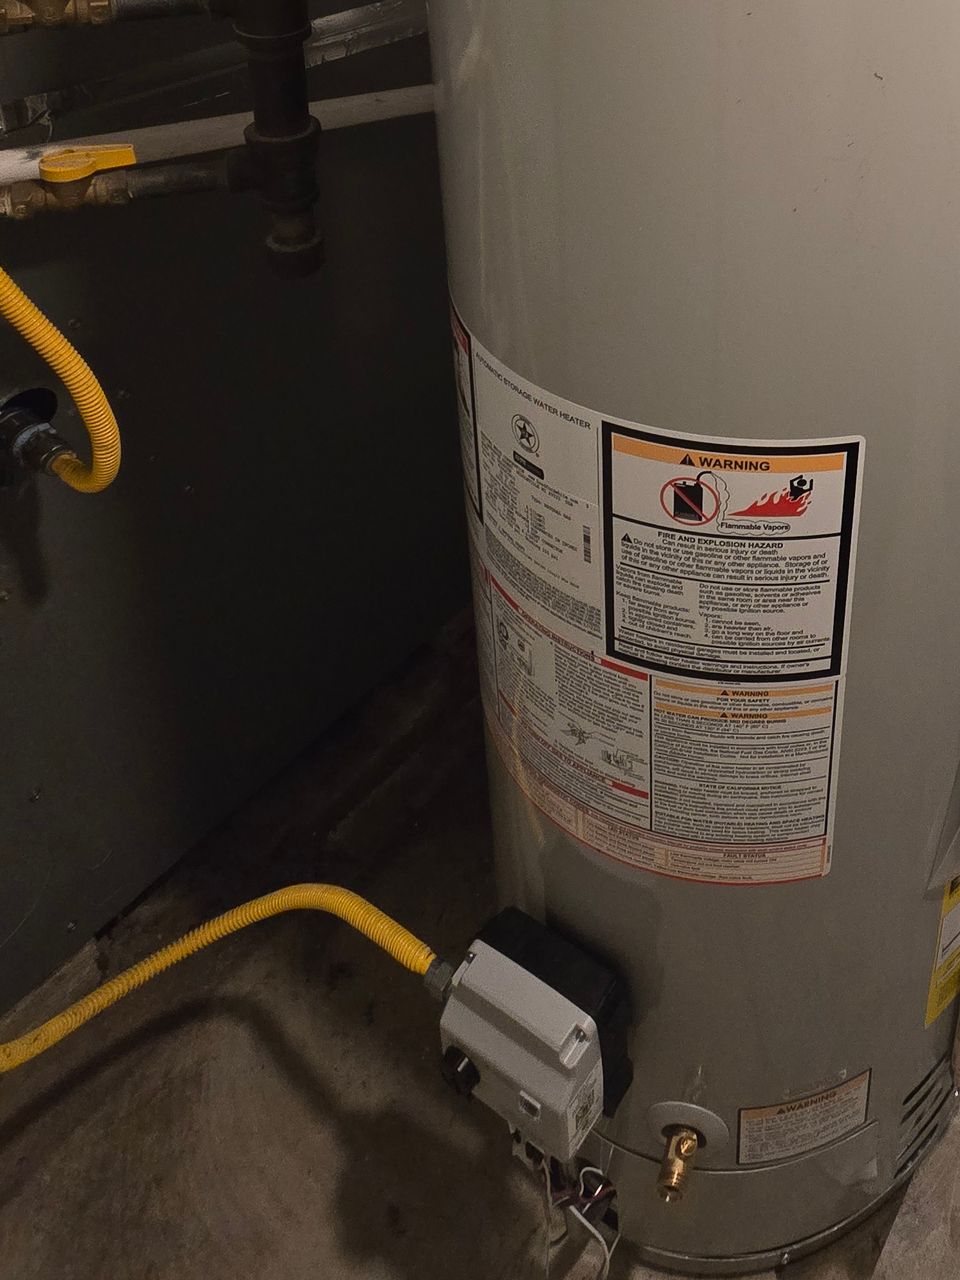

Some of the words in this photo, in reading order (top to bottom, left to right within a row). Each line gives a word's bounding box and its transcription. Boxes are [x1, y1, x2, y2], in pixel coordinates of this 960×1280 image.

[503, 377, 533, 402] STORAGE
[533, 398, 558, 417] WATER
[560, 410, 592, 430] HEATER
[698, 456, 770, 471] WARNING
[720, 522, 762, 530] Flammable
[764, 523, 789, 532] Vapors
[658, 531, 676, 540] FIRE
[678, 535, 696, 544] AND
[697, 538, 746, 548] EXPLOSION
[634, 538, 643, 546] Do
[694, 550, 723, 560] gasoline
[788, 554, 812, 562] vapors
[731, 568, 754, 576] vapors
[764, 568, 786, 576] liquids
[780, 574, 799, 582] injury
[786, 1091, 838, 1113] WARNING
